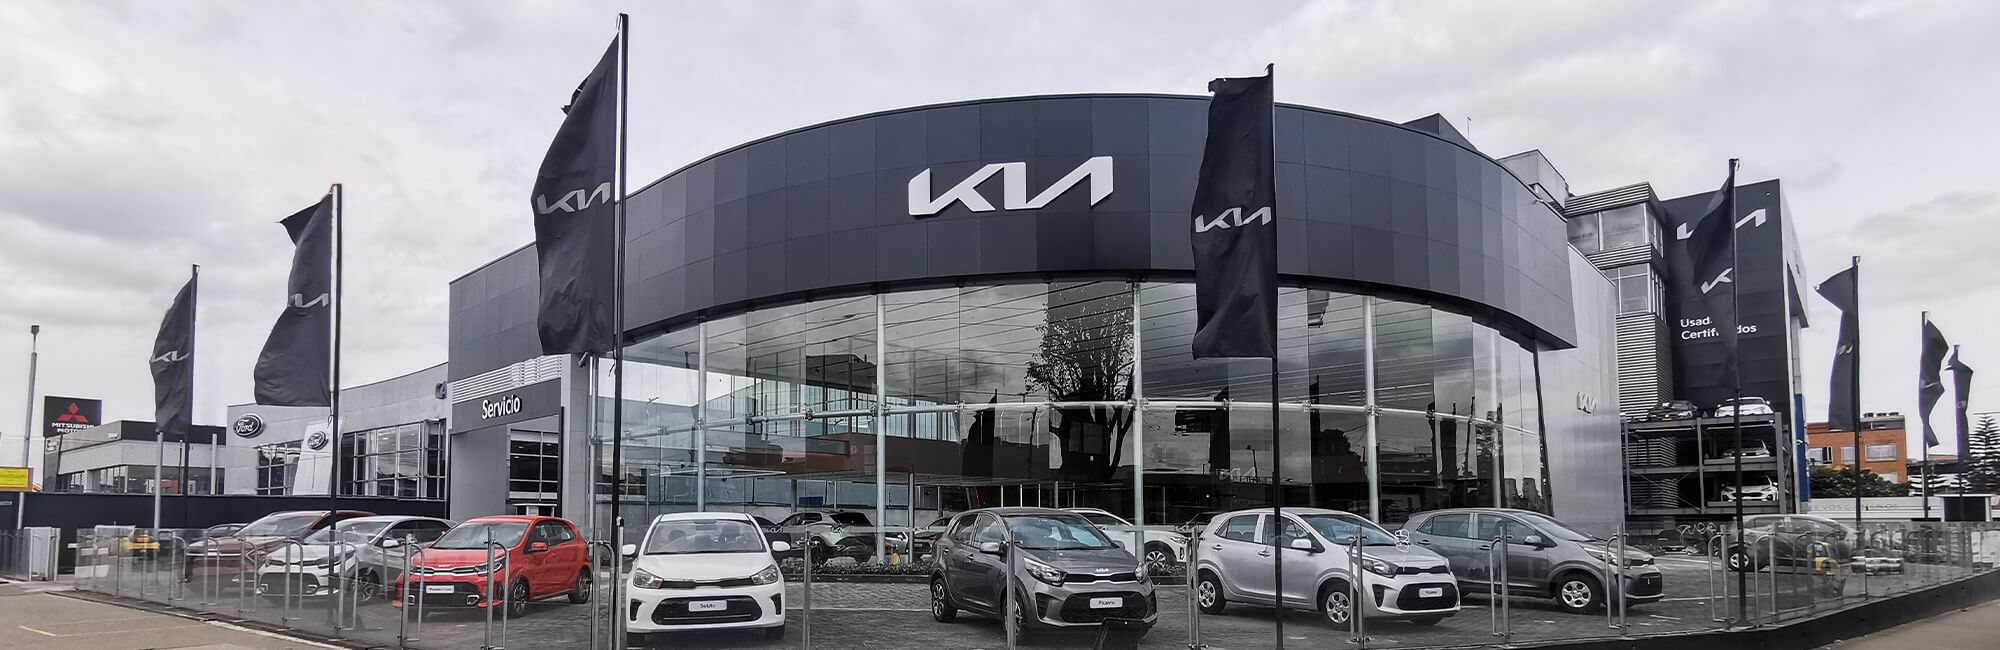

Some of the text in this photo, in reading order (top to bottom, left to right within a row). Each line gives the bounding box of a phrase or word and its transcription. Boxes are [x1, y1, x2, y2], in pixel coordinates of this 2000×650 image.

[536, 182, 611, 215] KIA
[908, 156, 1114, 216] KIA
[1194, 206, 1272, 233] KIA
[287, 292, 329, 308] IA
[1680, 316, 1713, 328] Usad
[1681, 324, 1758, 340] Certifdos
[482, 394, 521, 419] Servicio
